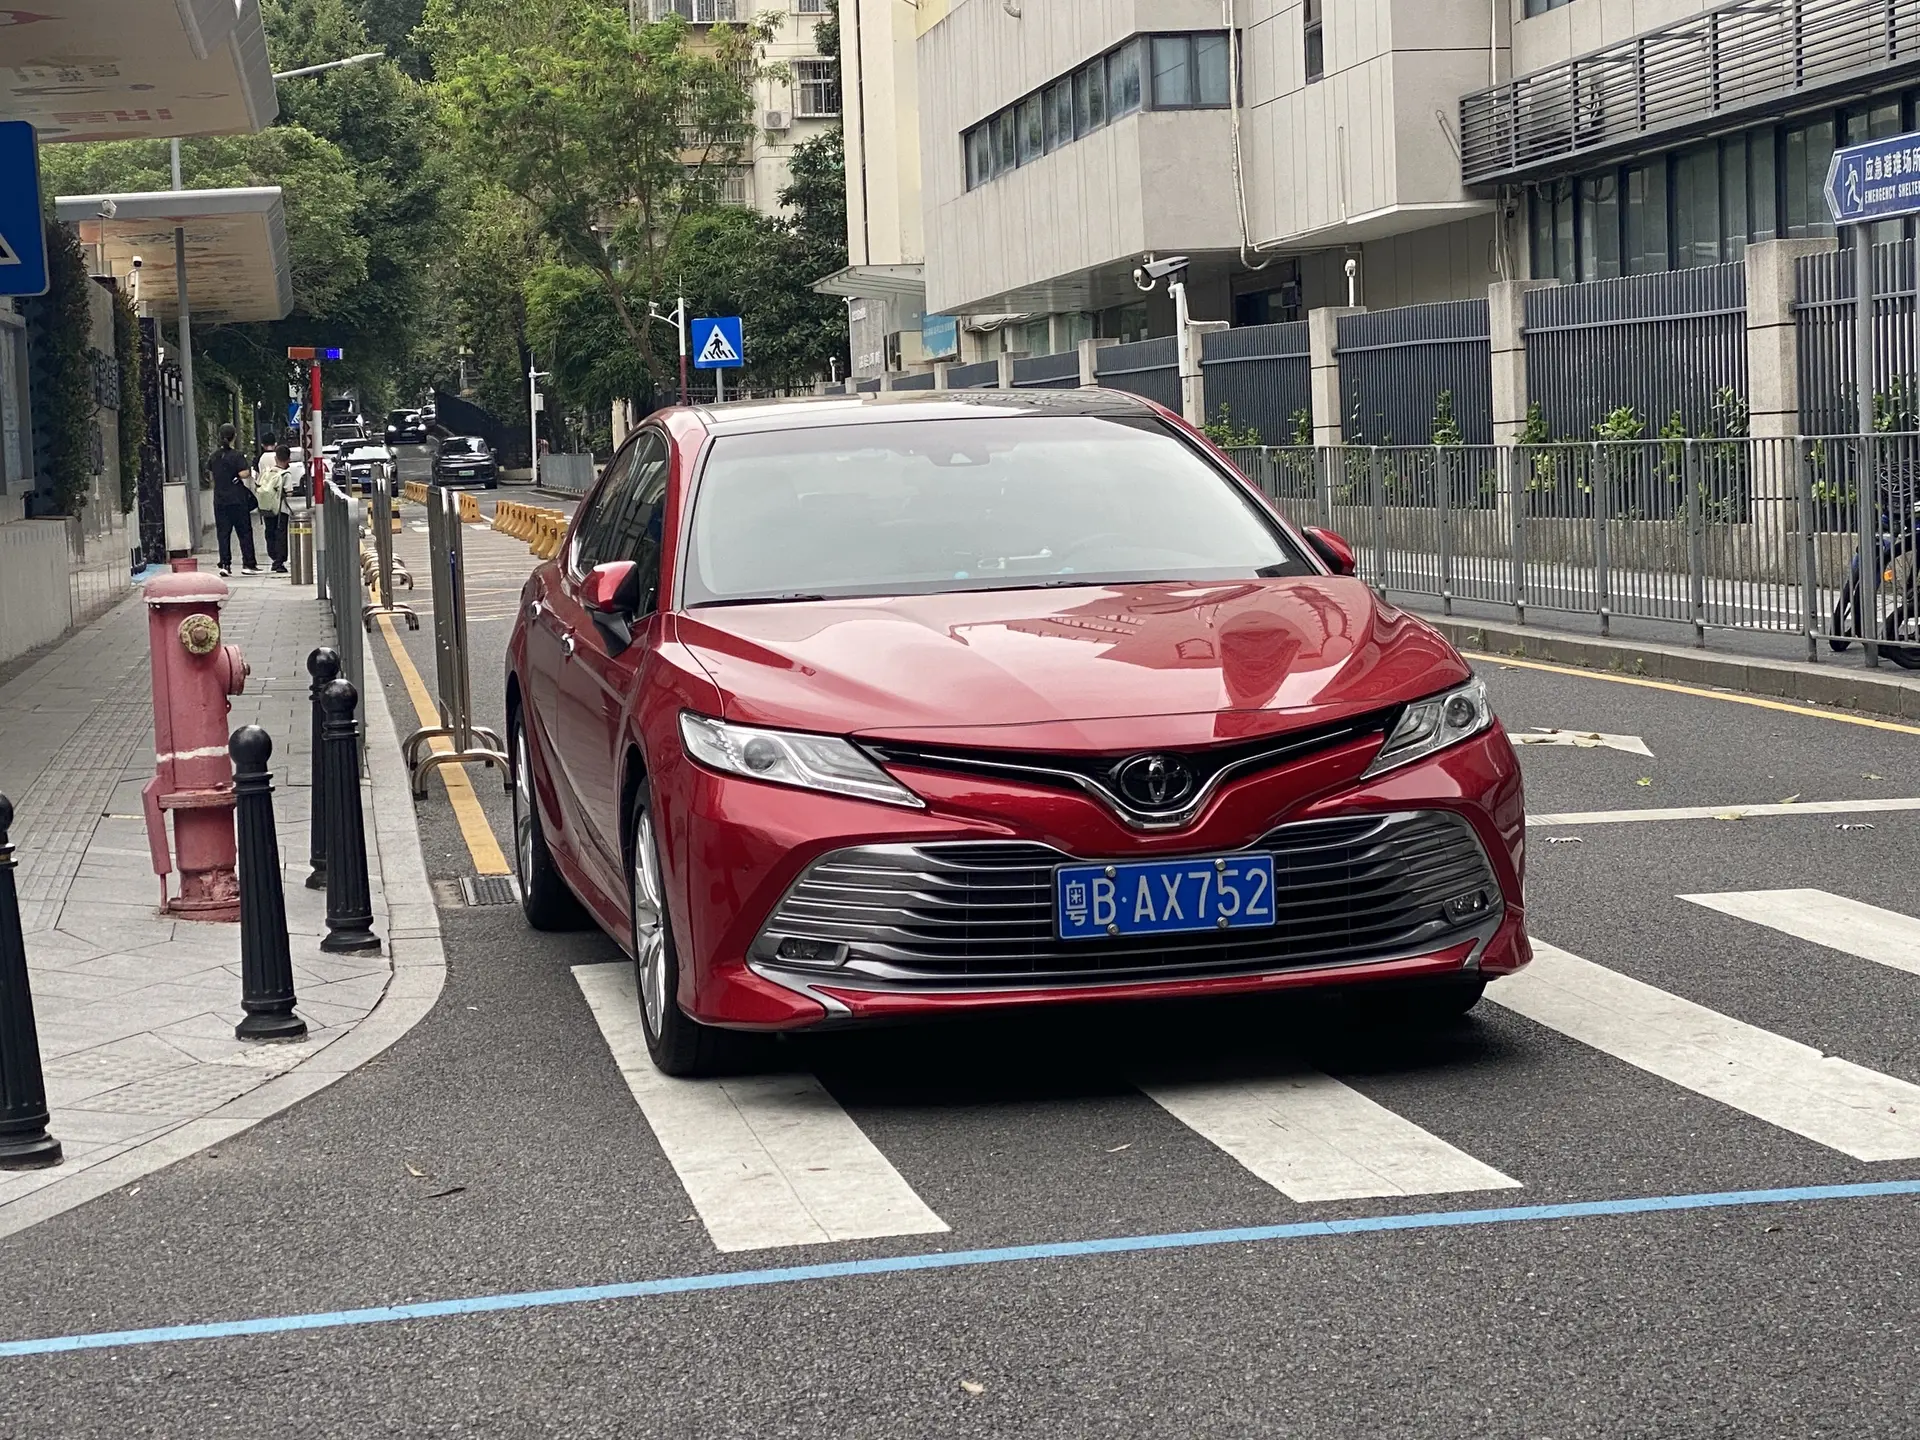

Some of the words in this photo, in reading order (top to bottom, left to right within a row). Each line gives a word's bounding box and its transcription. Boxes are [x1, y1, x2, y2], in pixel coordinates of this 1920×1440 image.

[1865, 147, 1920, 181] 应急避难场所
[1865, 185, 1896, 204] EMERGENCY
